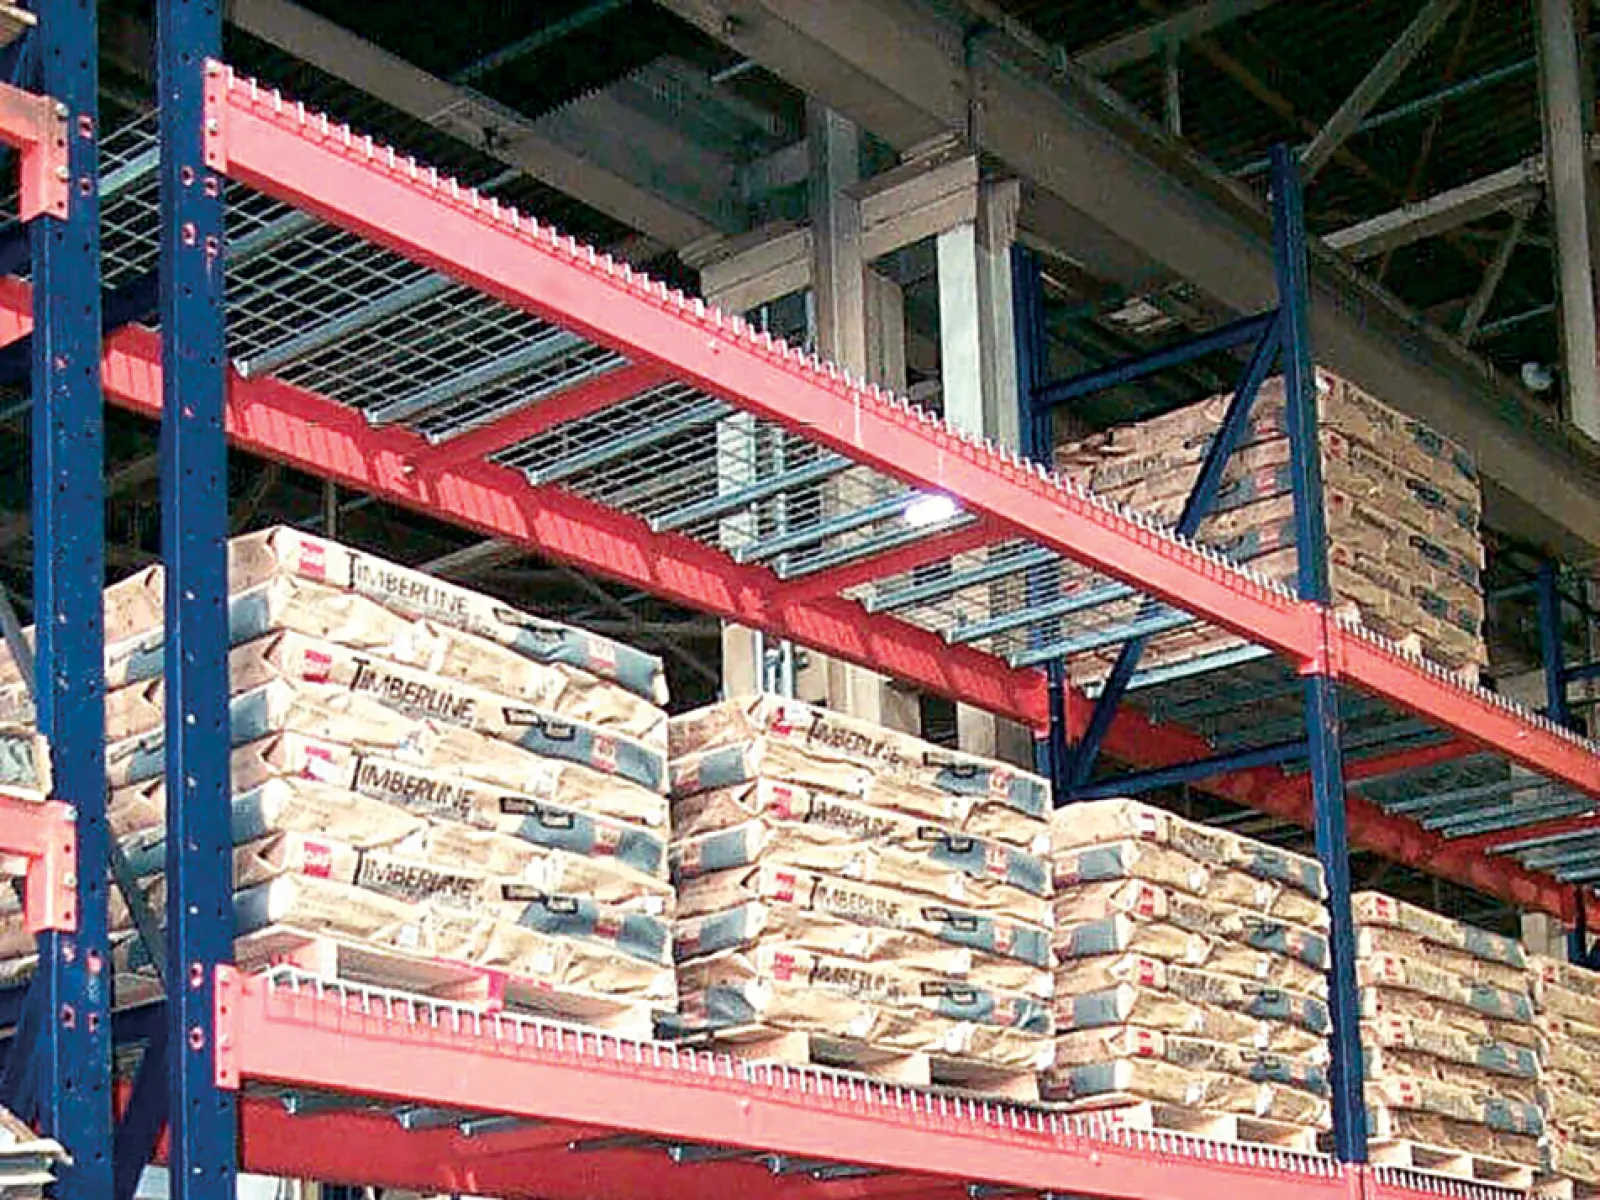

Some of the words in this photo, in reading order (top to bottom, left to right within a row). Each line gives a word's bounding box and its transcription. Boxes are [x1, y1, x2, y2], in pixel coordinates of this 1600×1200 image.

[345, 551, 468, 614] TIMBERLINE
[350, 657, 476, 721] TIMBERLINE
[351, 751, 476, 810] TIMBERLINE
[352, 844, 476, 897] TIMBERLINE
